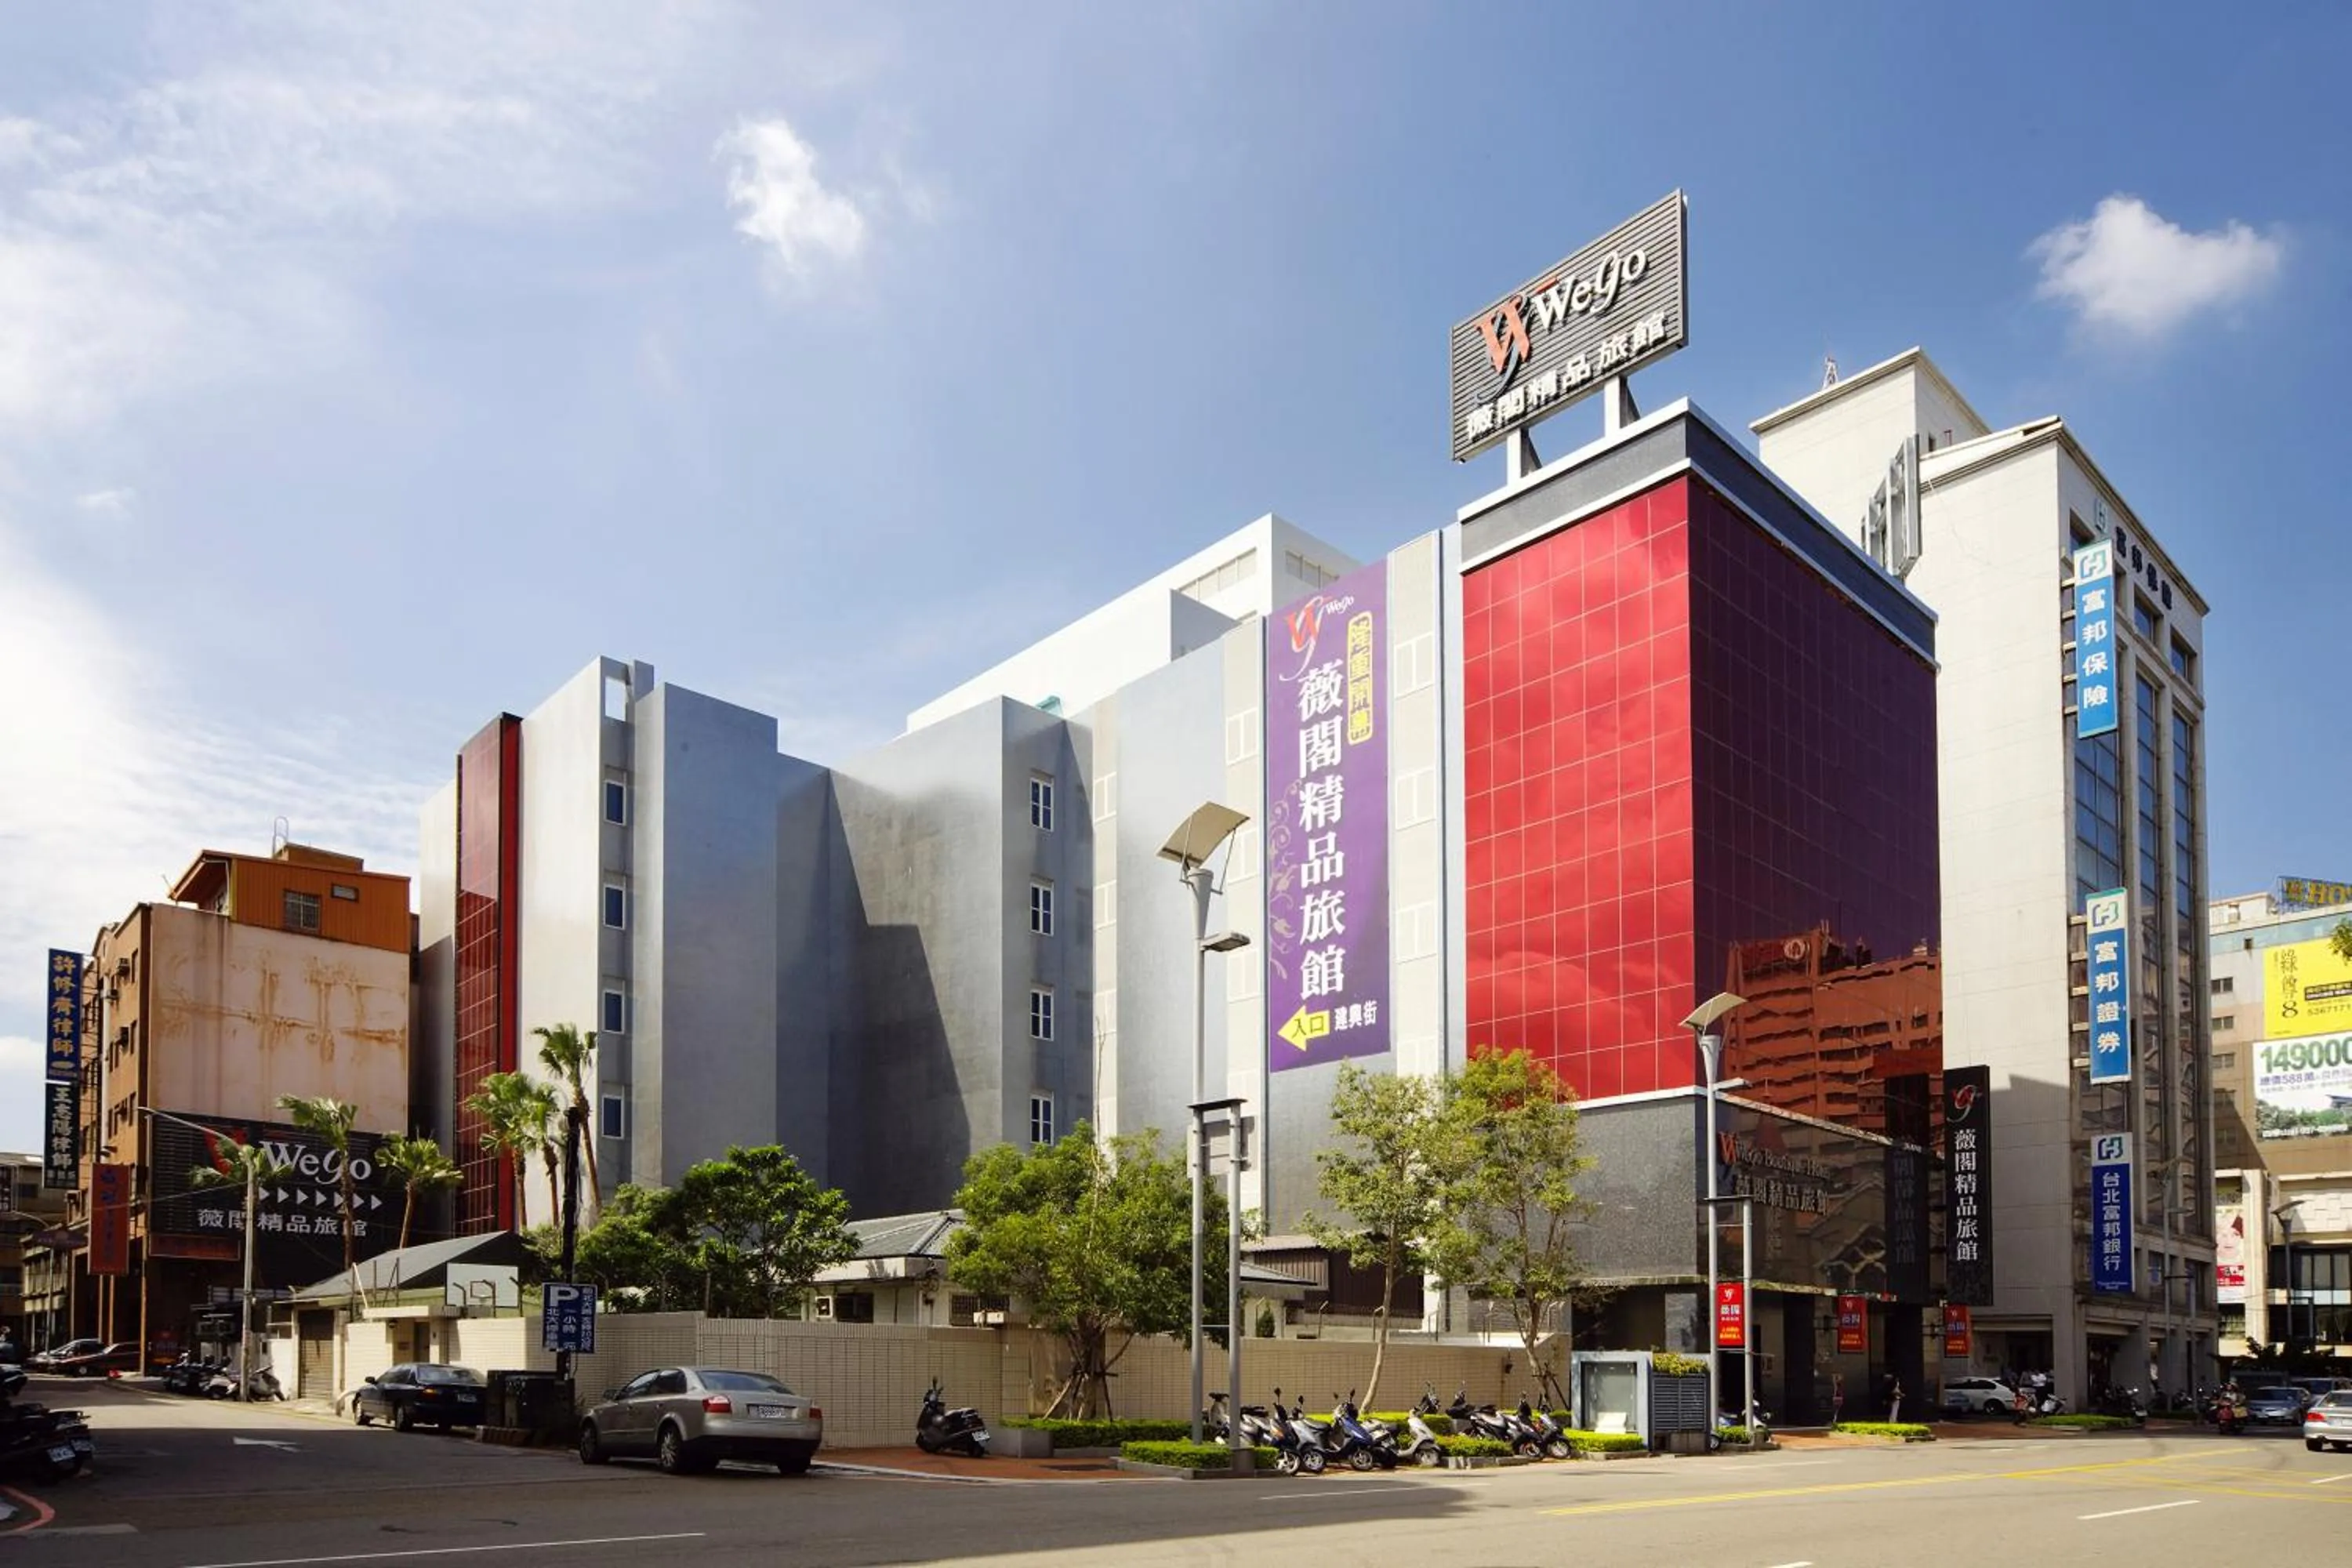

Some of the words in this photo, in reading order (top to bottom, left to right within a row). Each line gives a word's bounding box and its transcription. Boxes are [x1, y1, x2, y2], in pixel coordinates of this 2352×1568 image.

[2082, 590, 2108, 710] 富邦保險
[1298, 659, 1346, 1000] 薇閣精品旅館
[1291, 1014, 1325, 1039] 入口
[2094, 941, 2121, 1053] 富邦證券
[1955, 1129, 1978, 1261] 薇閣精品旅館
[2102, 1172, 2121, 1272] 台北富邦銀行
[550, 1286, 579, 1307] P
